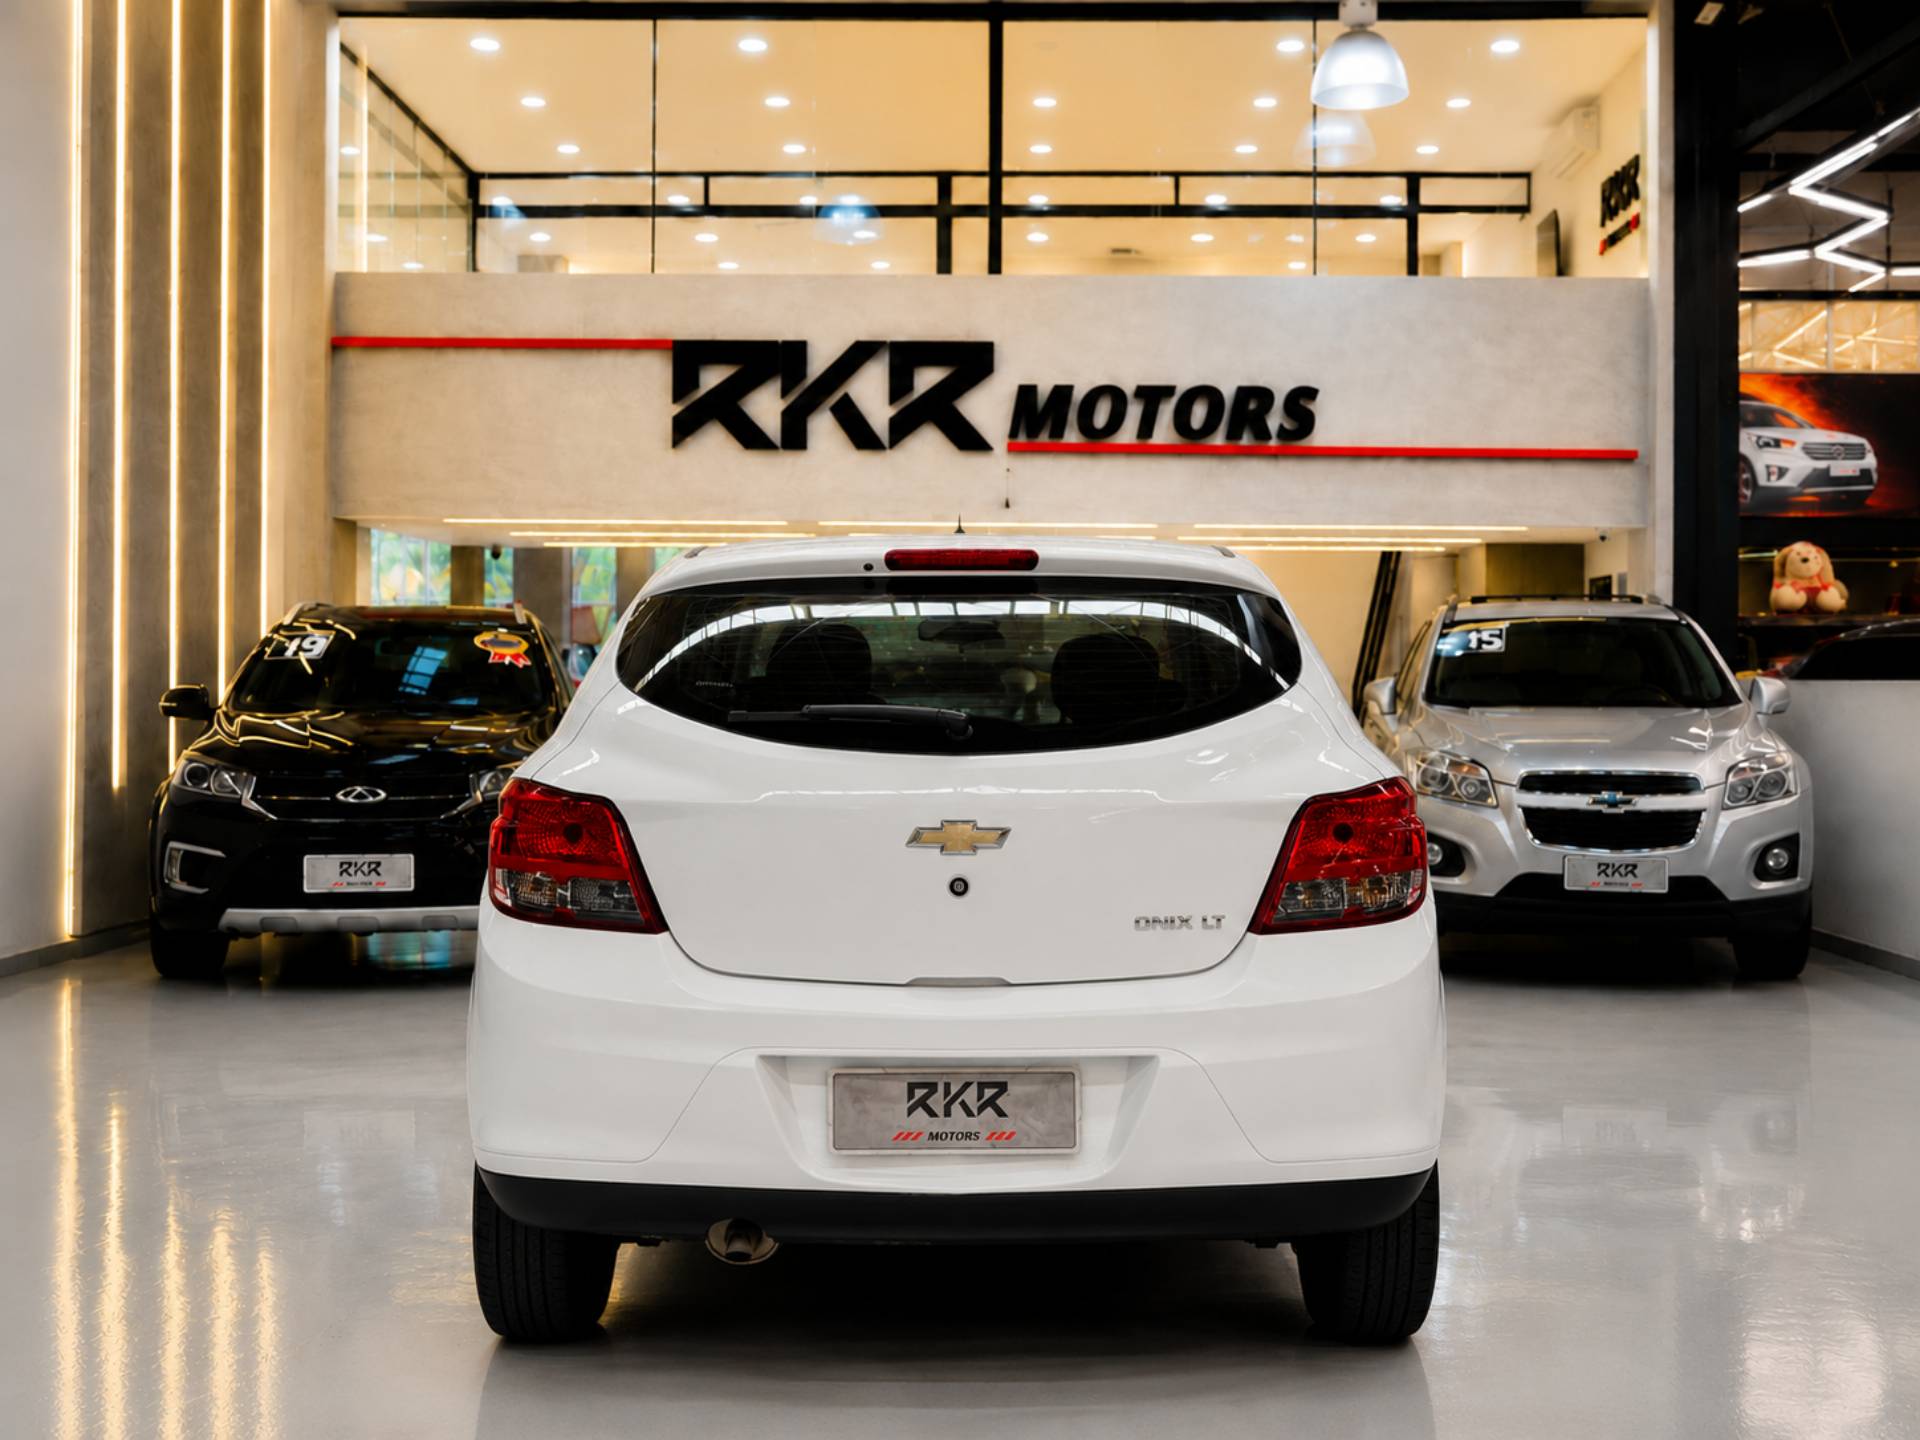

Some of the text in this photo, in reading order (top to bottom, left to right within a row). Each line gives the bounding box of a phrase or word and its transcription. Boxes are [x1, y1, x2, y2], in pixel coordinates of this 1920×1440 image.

[672, 340, 1319, 450] RKR MOTORS
[284, 636, 327, 657] 19
[1469, 629, 1502, 650] 15
[339, 861, 381, 877] RKR
[1597, 862, 1638, 878] RKR
[1134, 915, 1226, 931] ONIX LT
[906, 1081, 1009, 1118] RKR
[927, 1131, 981, 1142] MOTORS
